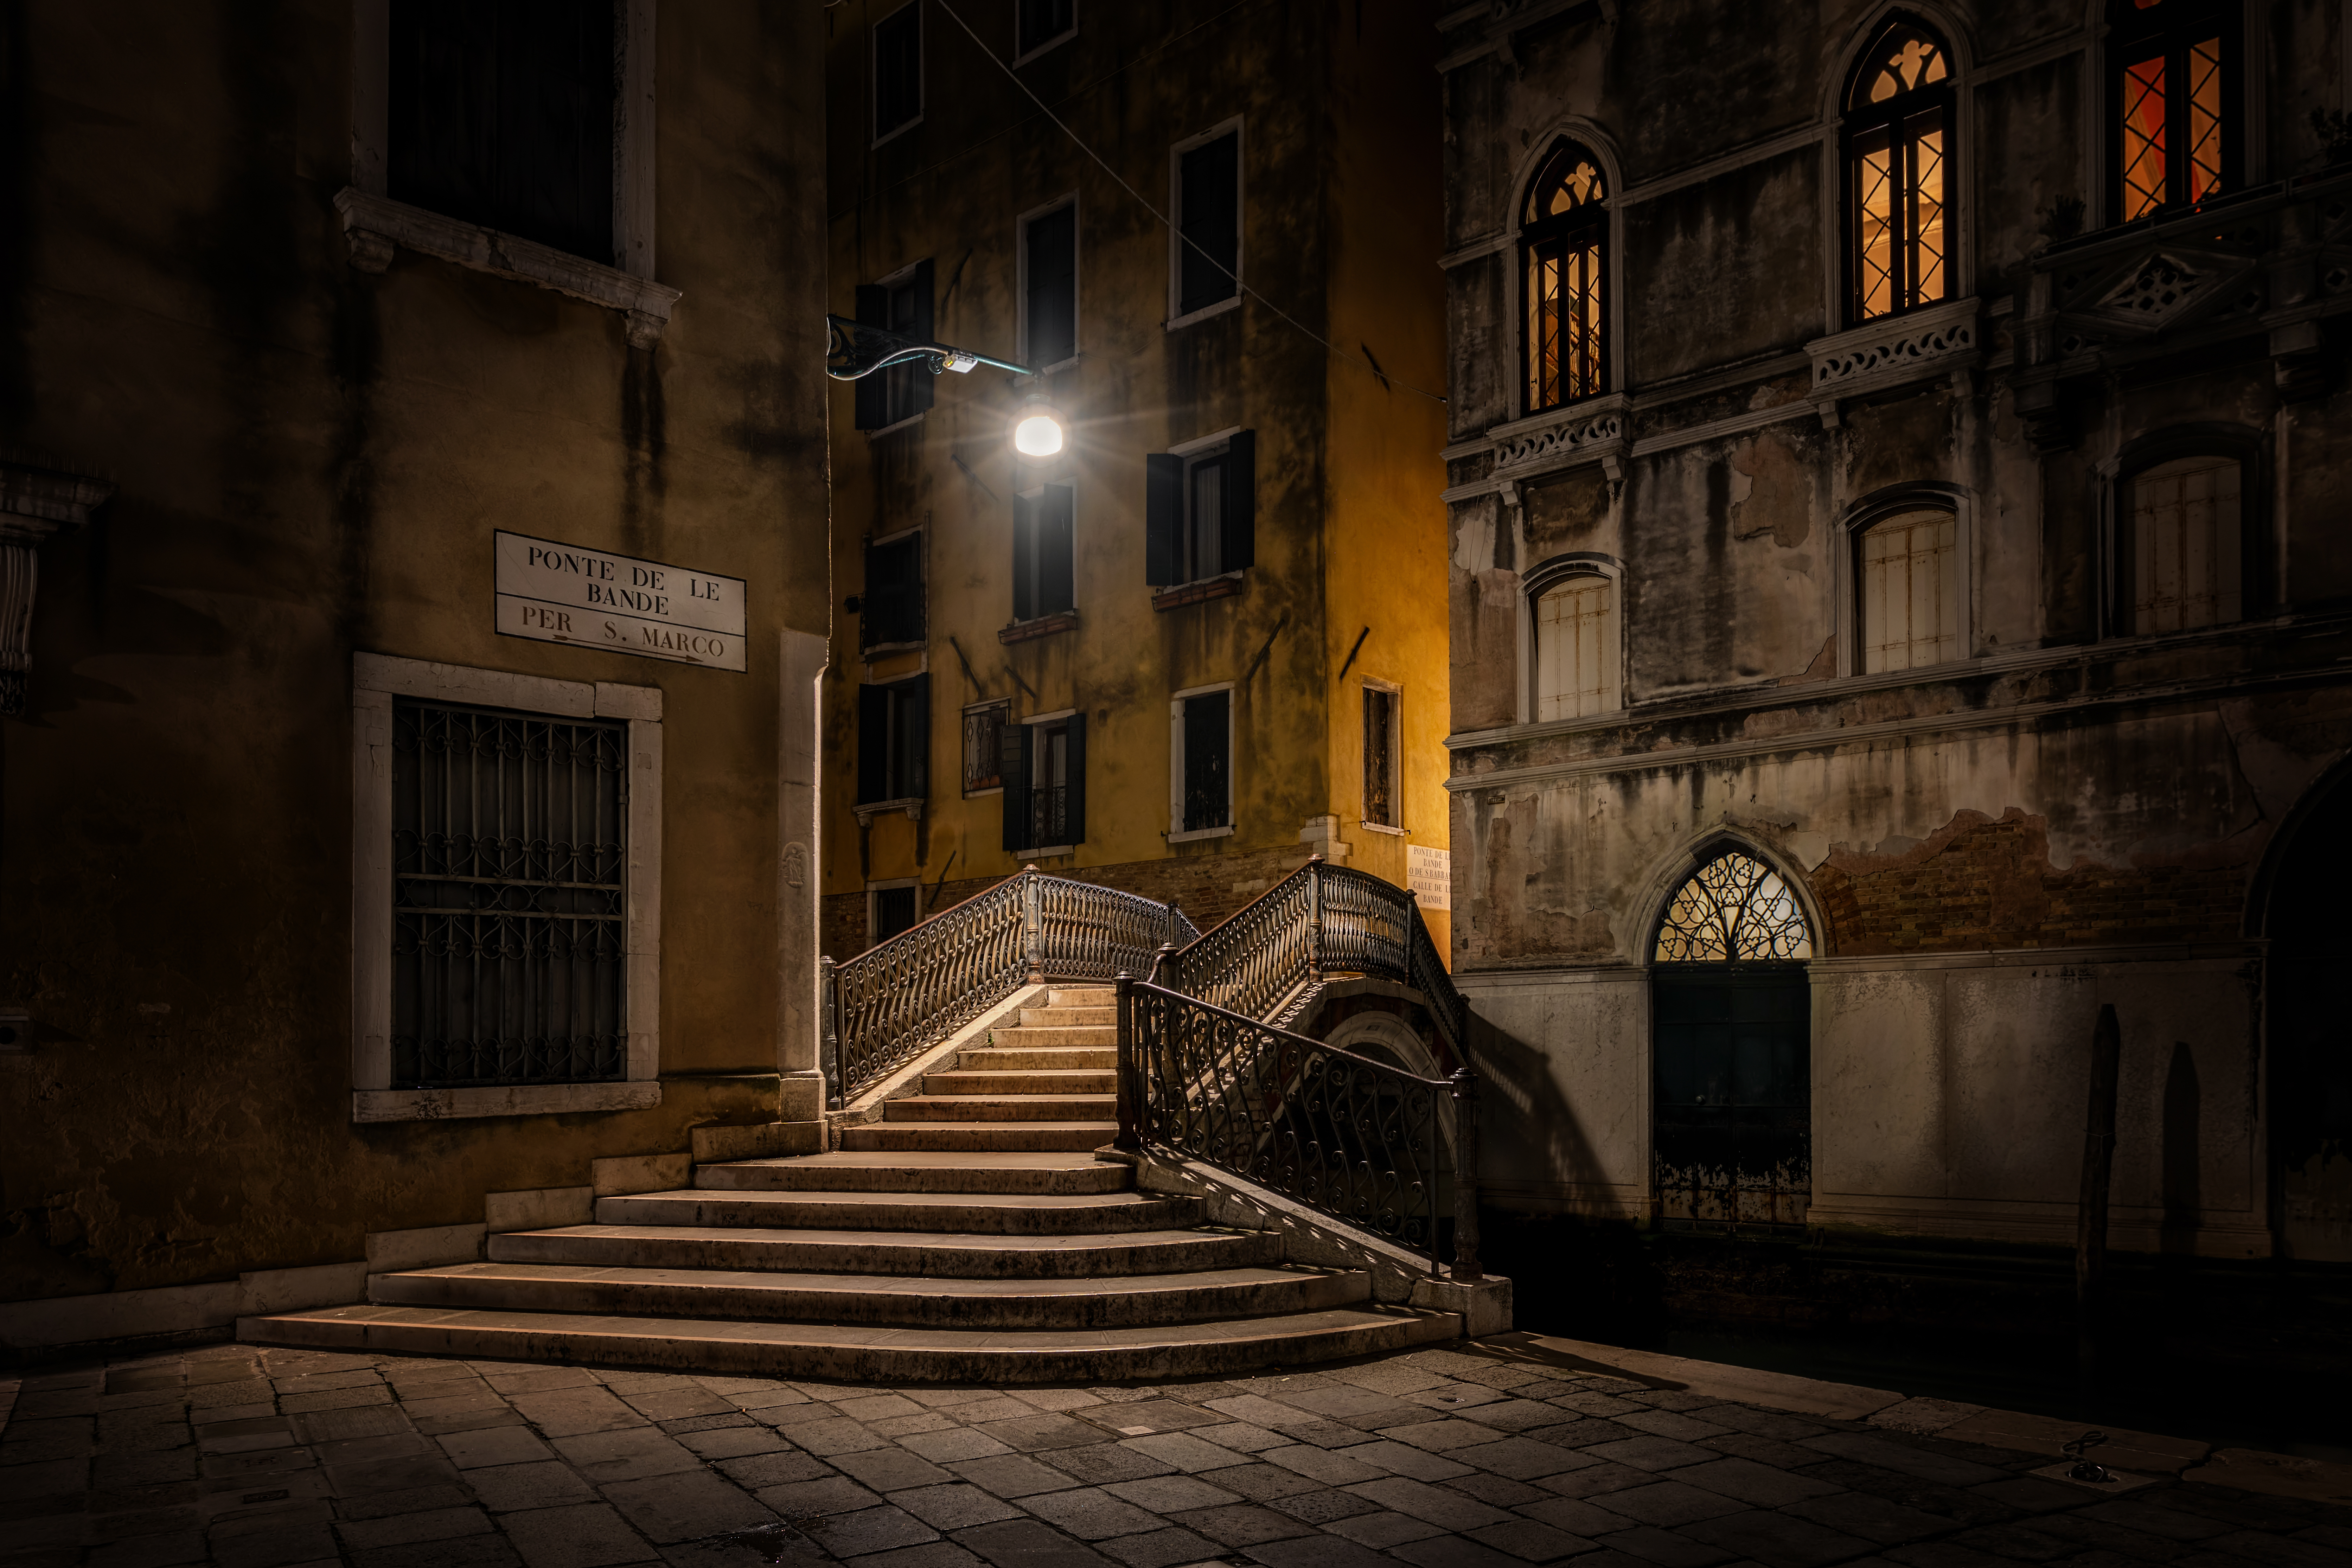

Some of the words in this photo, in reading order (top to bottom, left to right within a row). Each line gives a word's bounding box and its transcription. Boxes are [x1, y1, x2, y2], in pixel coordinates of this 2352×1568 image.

[529, 546, 614, 581] PONTE
[632, 567, 664, 590] DE
[690, 578, 719, 601] LE
[587, 583, 668, 615] BANDE
[522, 606, 572, 633] PER
[604, 621, 627, 641] S.
[643, 627, 724, 657] MARCO
[1414, 847, 1432, 857] PONTE
[1435, 851, 1443, 859] DE
[1424, 858, 1442, 869] BANDE
[1415, 868, 1423, 876] DE
[1413, 881, 1432, 890] CALLE
[1435, 884, 1442, 892] DE
[1423, 895, 1442, 904] BANDE
